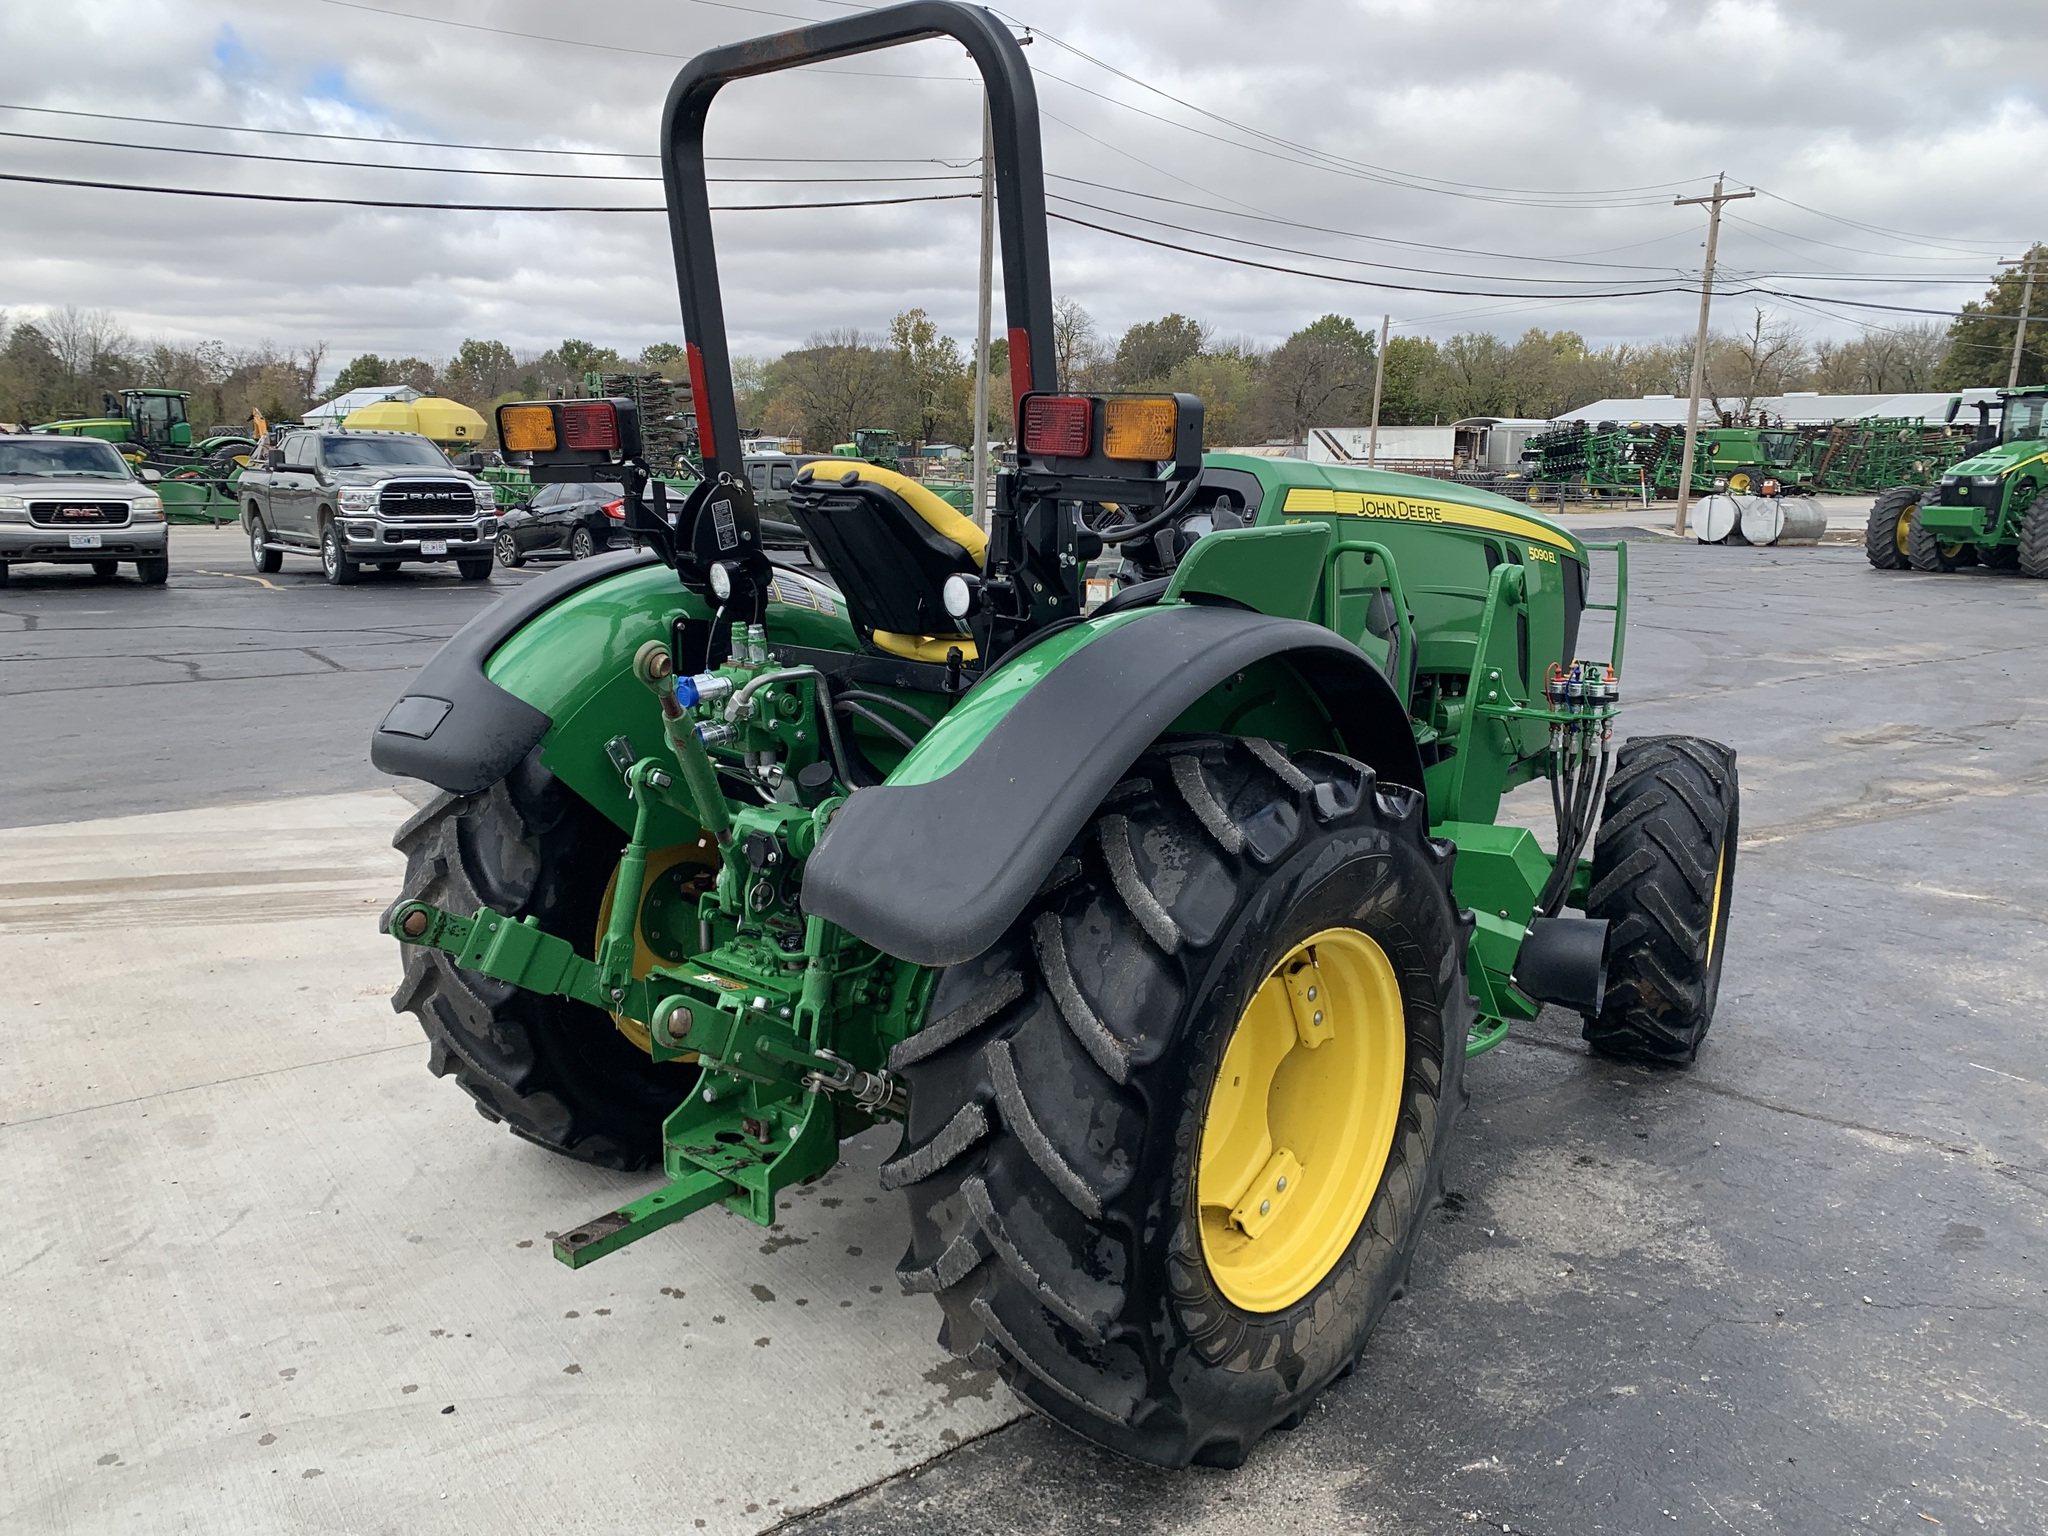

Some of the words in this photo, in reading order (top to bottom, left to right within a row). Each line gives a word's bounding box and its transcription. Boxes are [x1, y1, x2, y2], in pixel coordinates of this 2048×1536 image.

[63, 508, 98, 517] GMC
[1358, 498, 1397, 517] JOHN
[1398, 501, 1443, 521] DEERE
[1528, 546, 1549, 561] 5090
